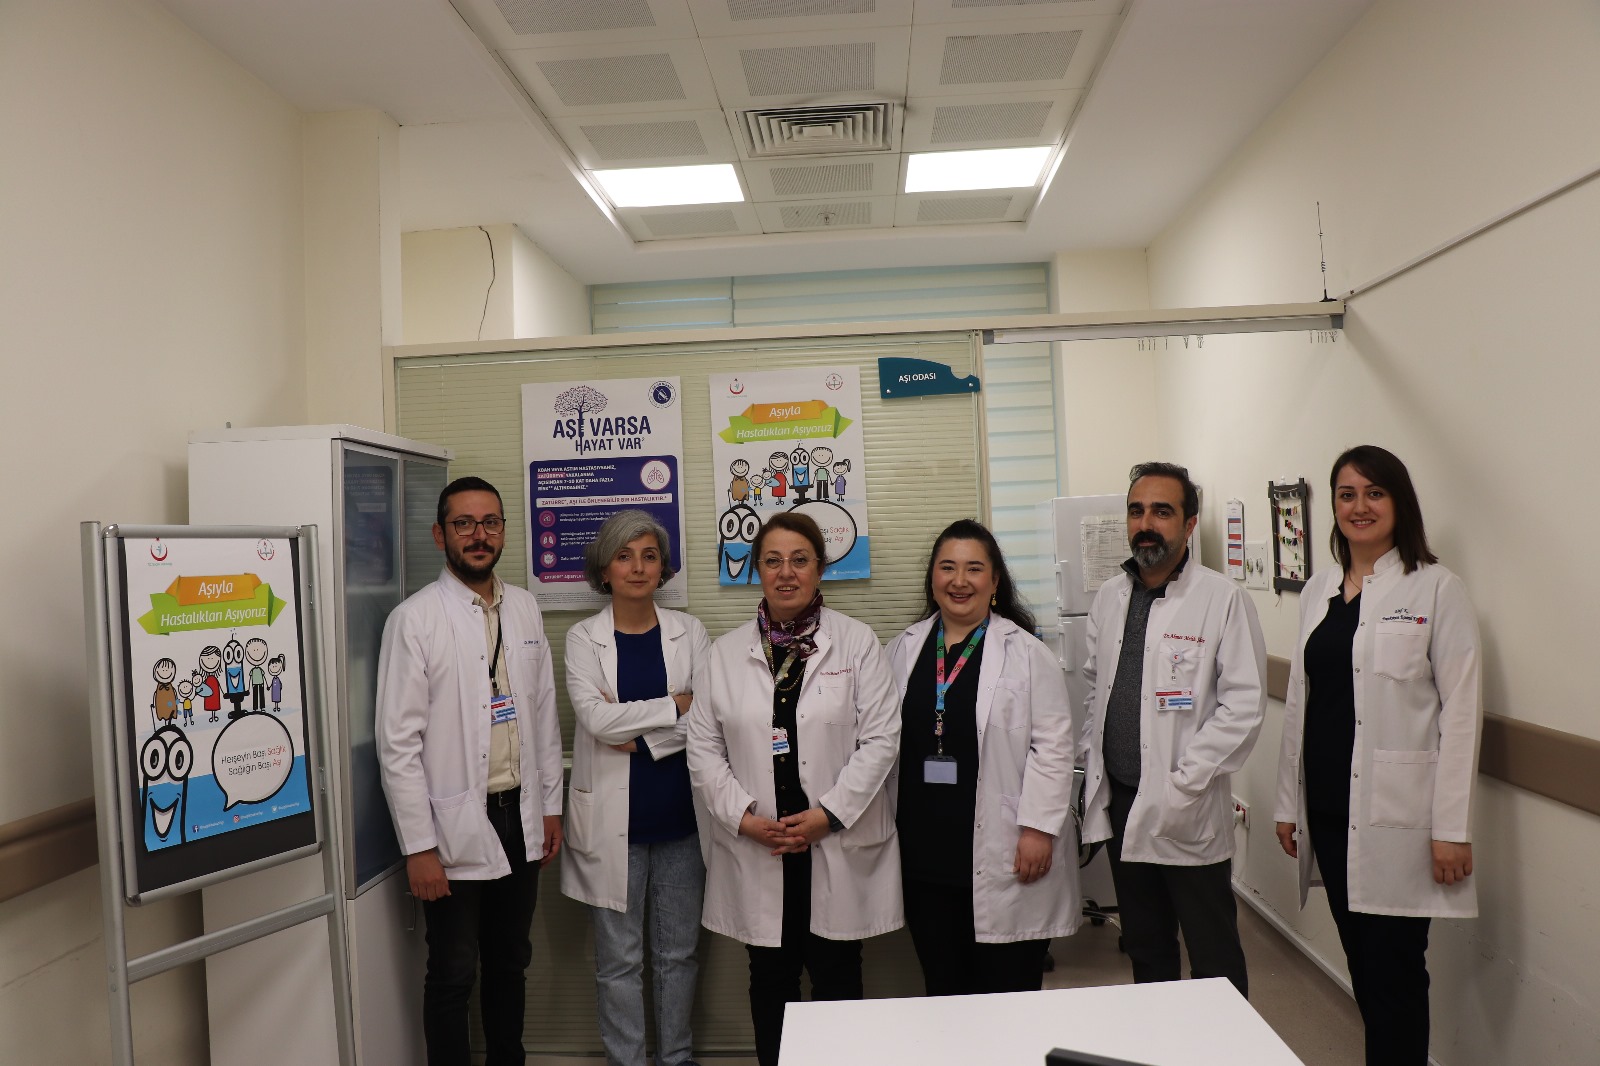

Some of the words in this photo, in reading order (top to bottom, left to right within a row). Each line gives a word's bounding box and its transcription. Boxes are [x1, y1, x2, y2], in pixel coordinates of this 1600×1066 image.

[898, 374, 911, 384] AŞI
[912, 372, 937, 381] ODASI
[769, 405, 801, 419] Aşıyla
[589, 415, 652, 437] VARSA
[793, 423, 833, 436] Aşıyoruz
[575, 438, 614, 452] HAYAT
[198, 580, 233, 599] Aşıyla
[160, 611, 223, 627] Hastalıkları
[224, 607, 267, 623] Aşıyoruz
